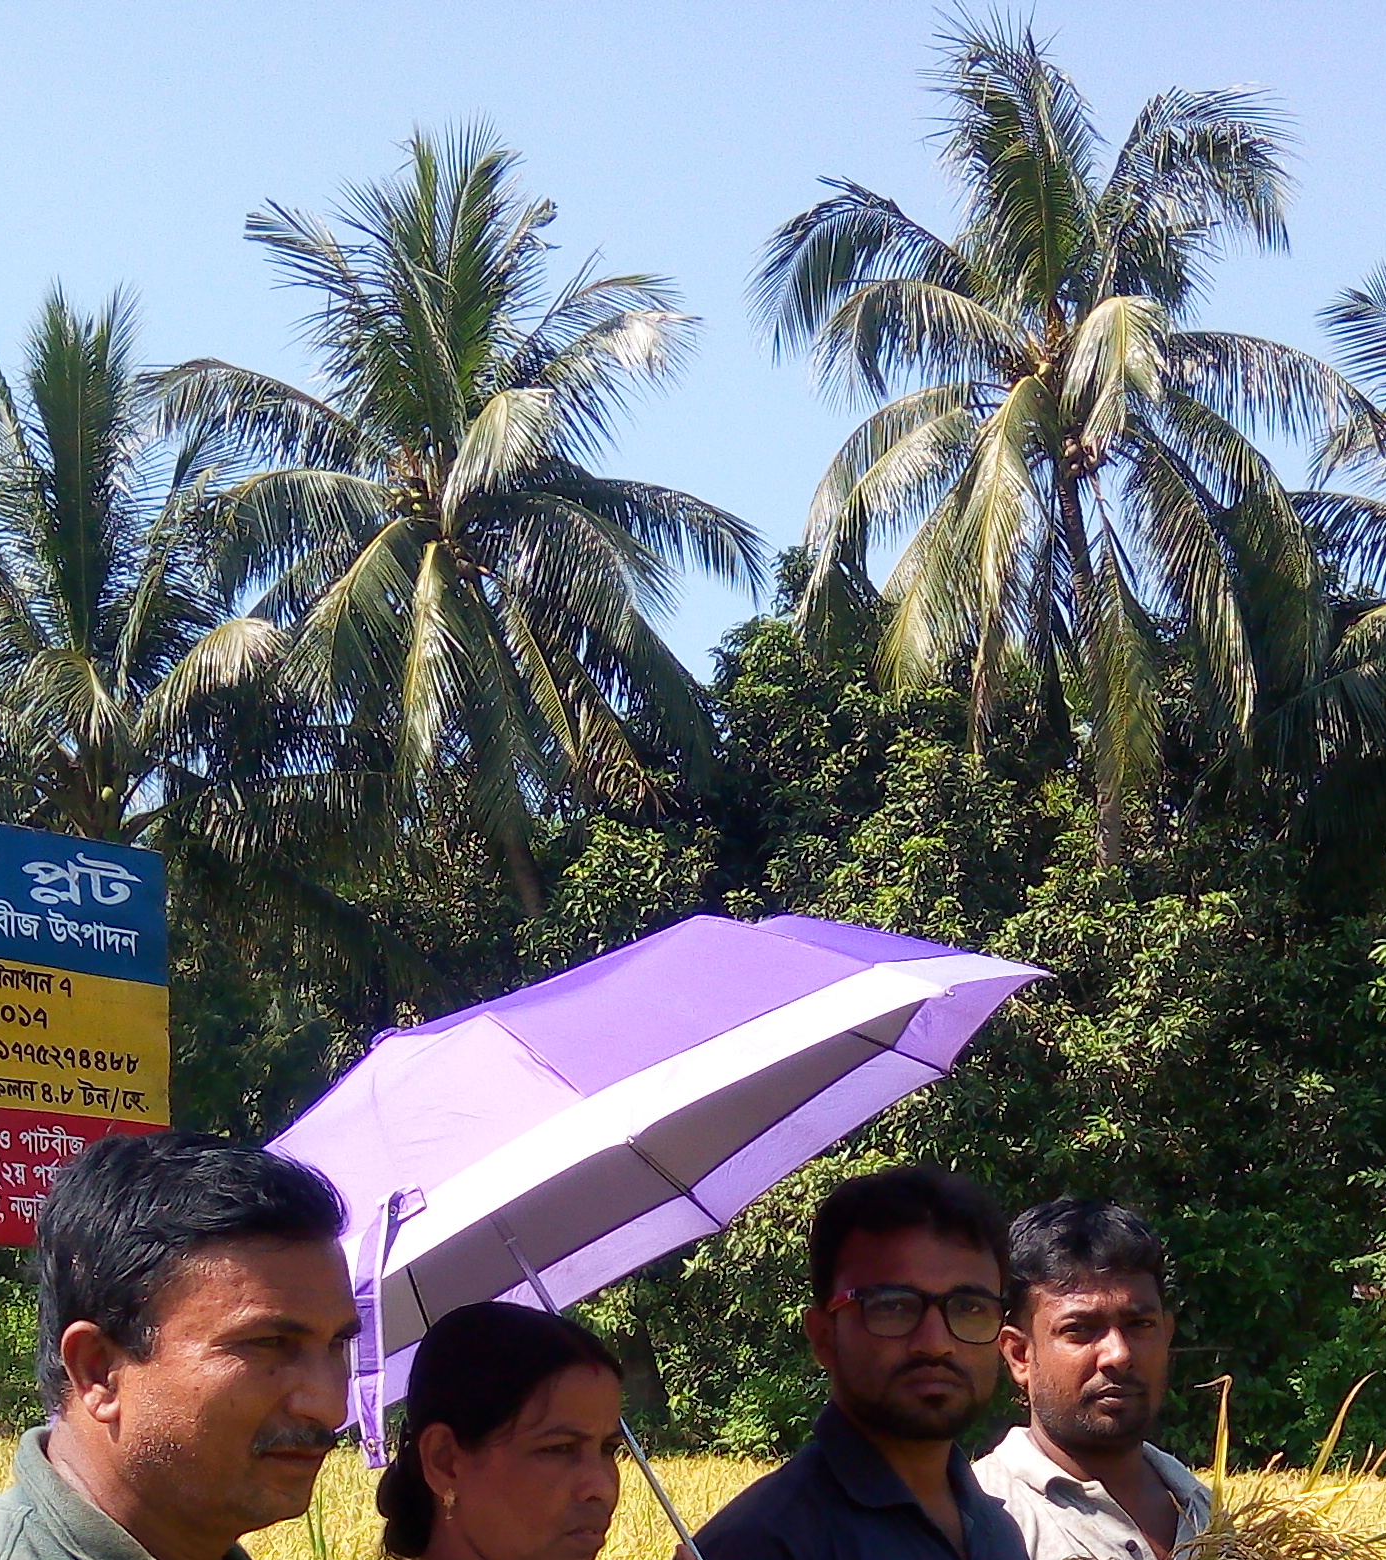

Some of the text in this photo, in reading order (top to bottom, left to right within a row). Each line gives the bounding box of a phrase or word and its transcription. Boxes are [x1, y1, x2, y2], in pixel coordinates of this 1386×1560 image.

[21, 852, 143, 906] প্লট
[46, 909, 140, 957] উৎপাদন
[59, 978, 73, 997] ৭
[41, 1082, 74, 1105] ৪.৮
